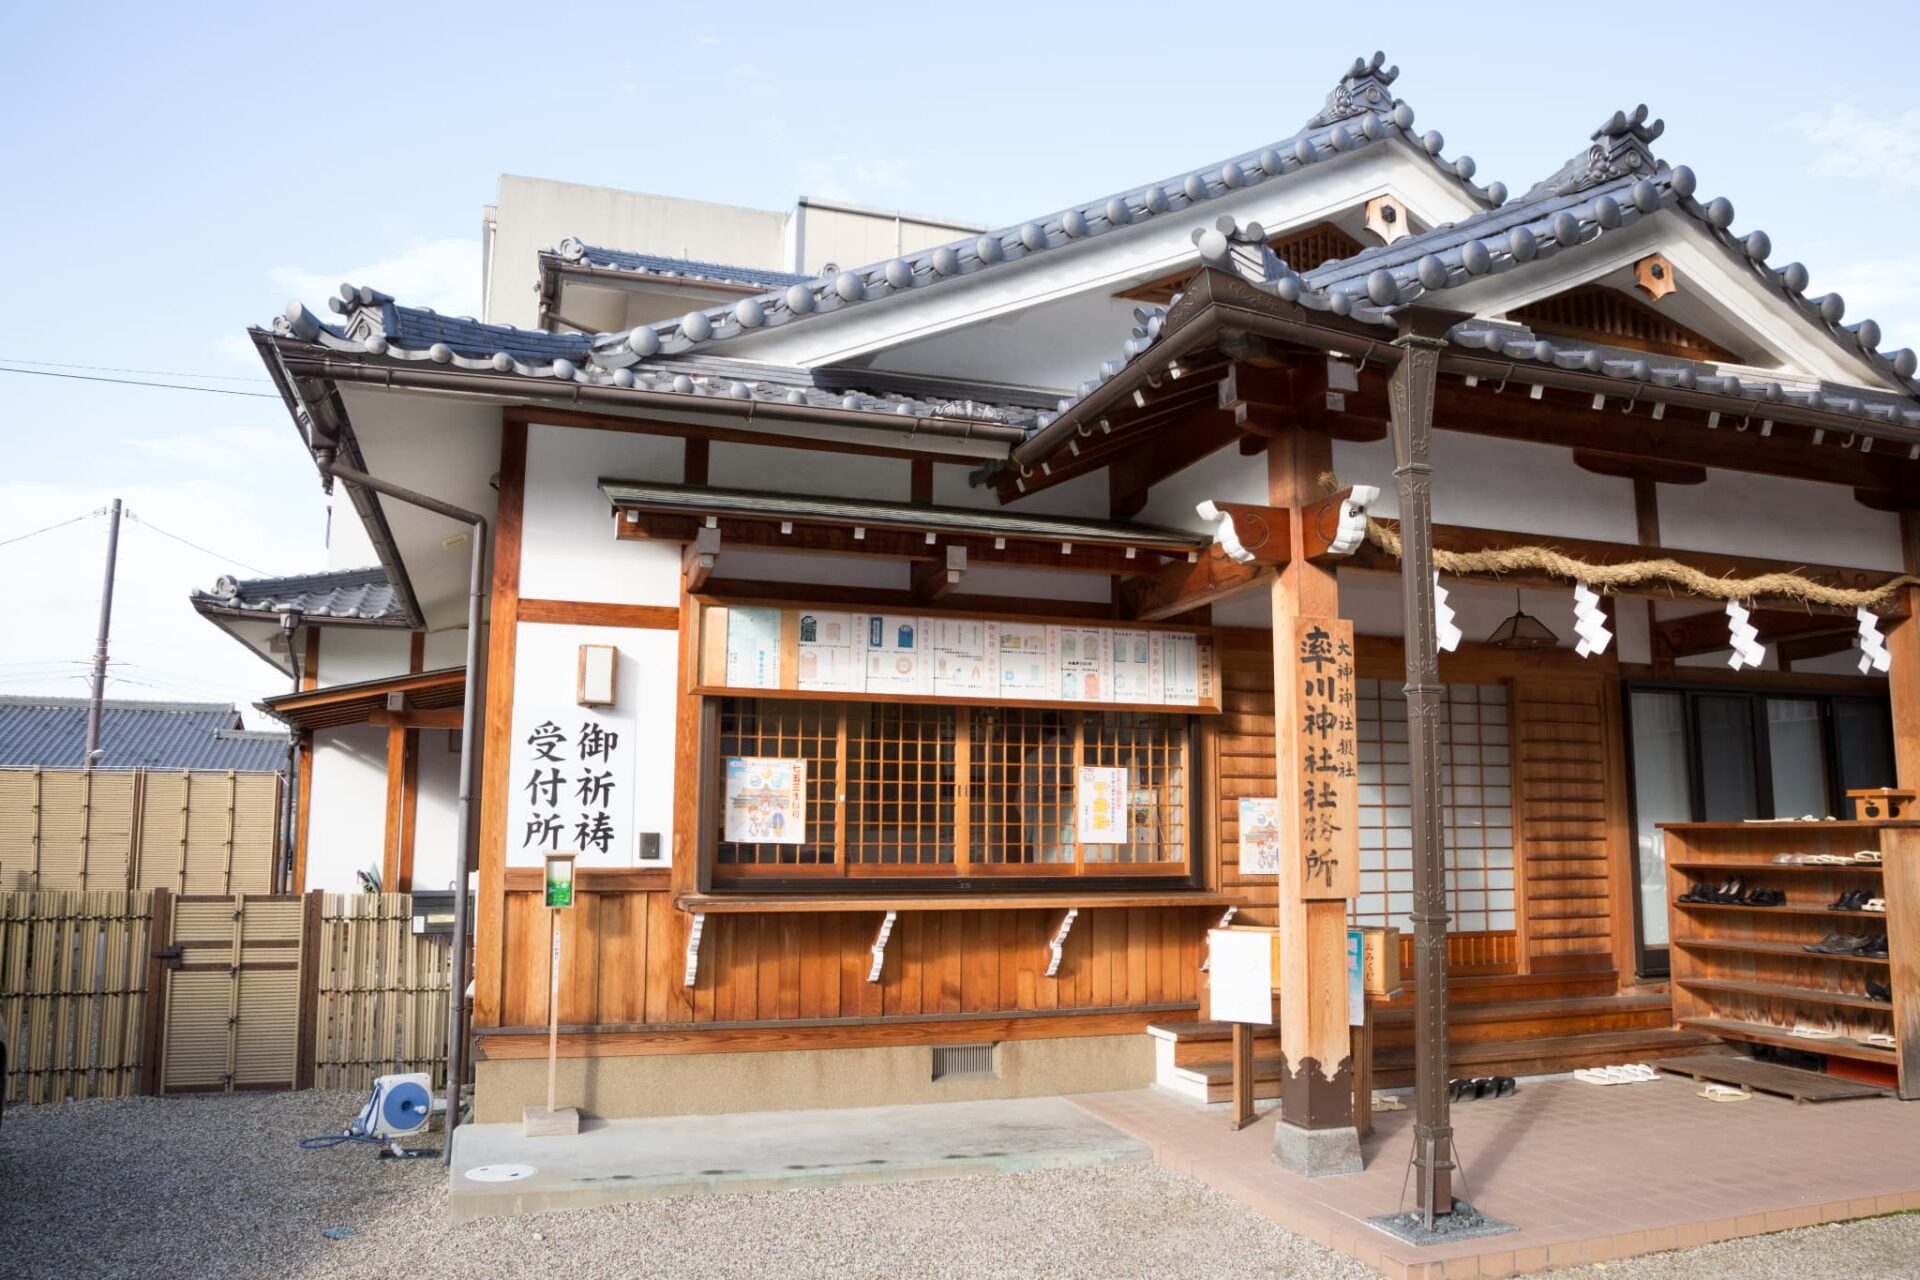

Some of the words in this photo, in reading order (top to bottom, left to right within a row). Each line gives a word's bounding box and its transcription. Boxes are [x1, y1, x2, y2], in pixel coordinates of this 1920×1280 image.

[522, 720, 568, 850] 受付所
[573, 722, 619, 854] 御祈祷
[1300, 626, 1342, 888] 率川神社社務所
[1365, 943, 1375, 981] おみくじ
